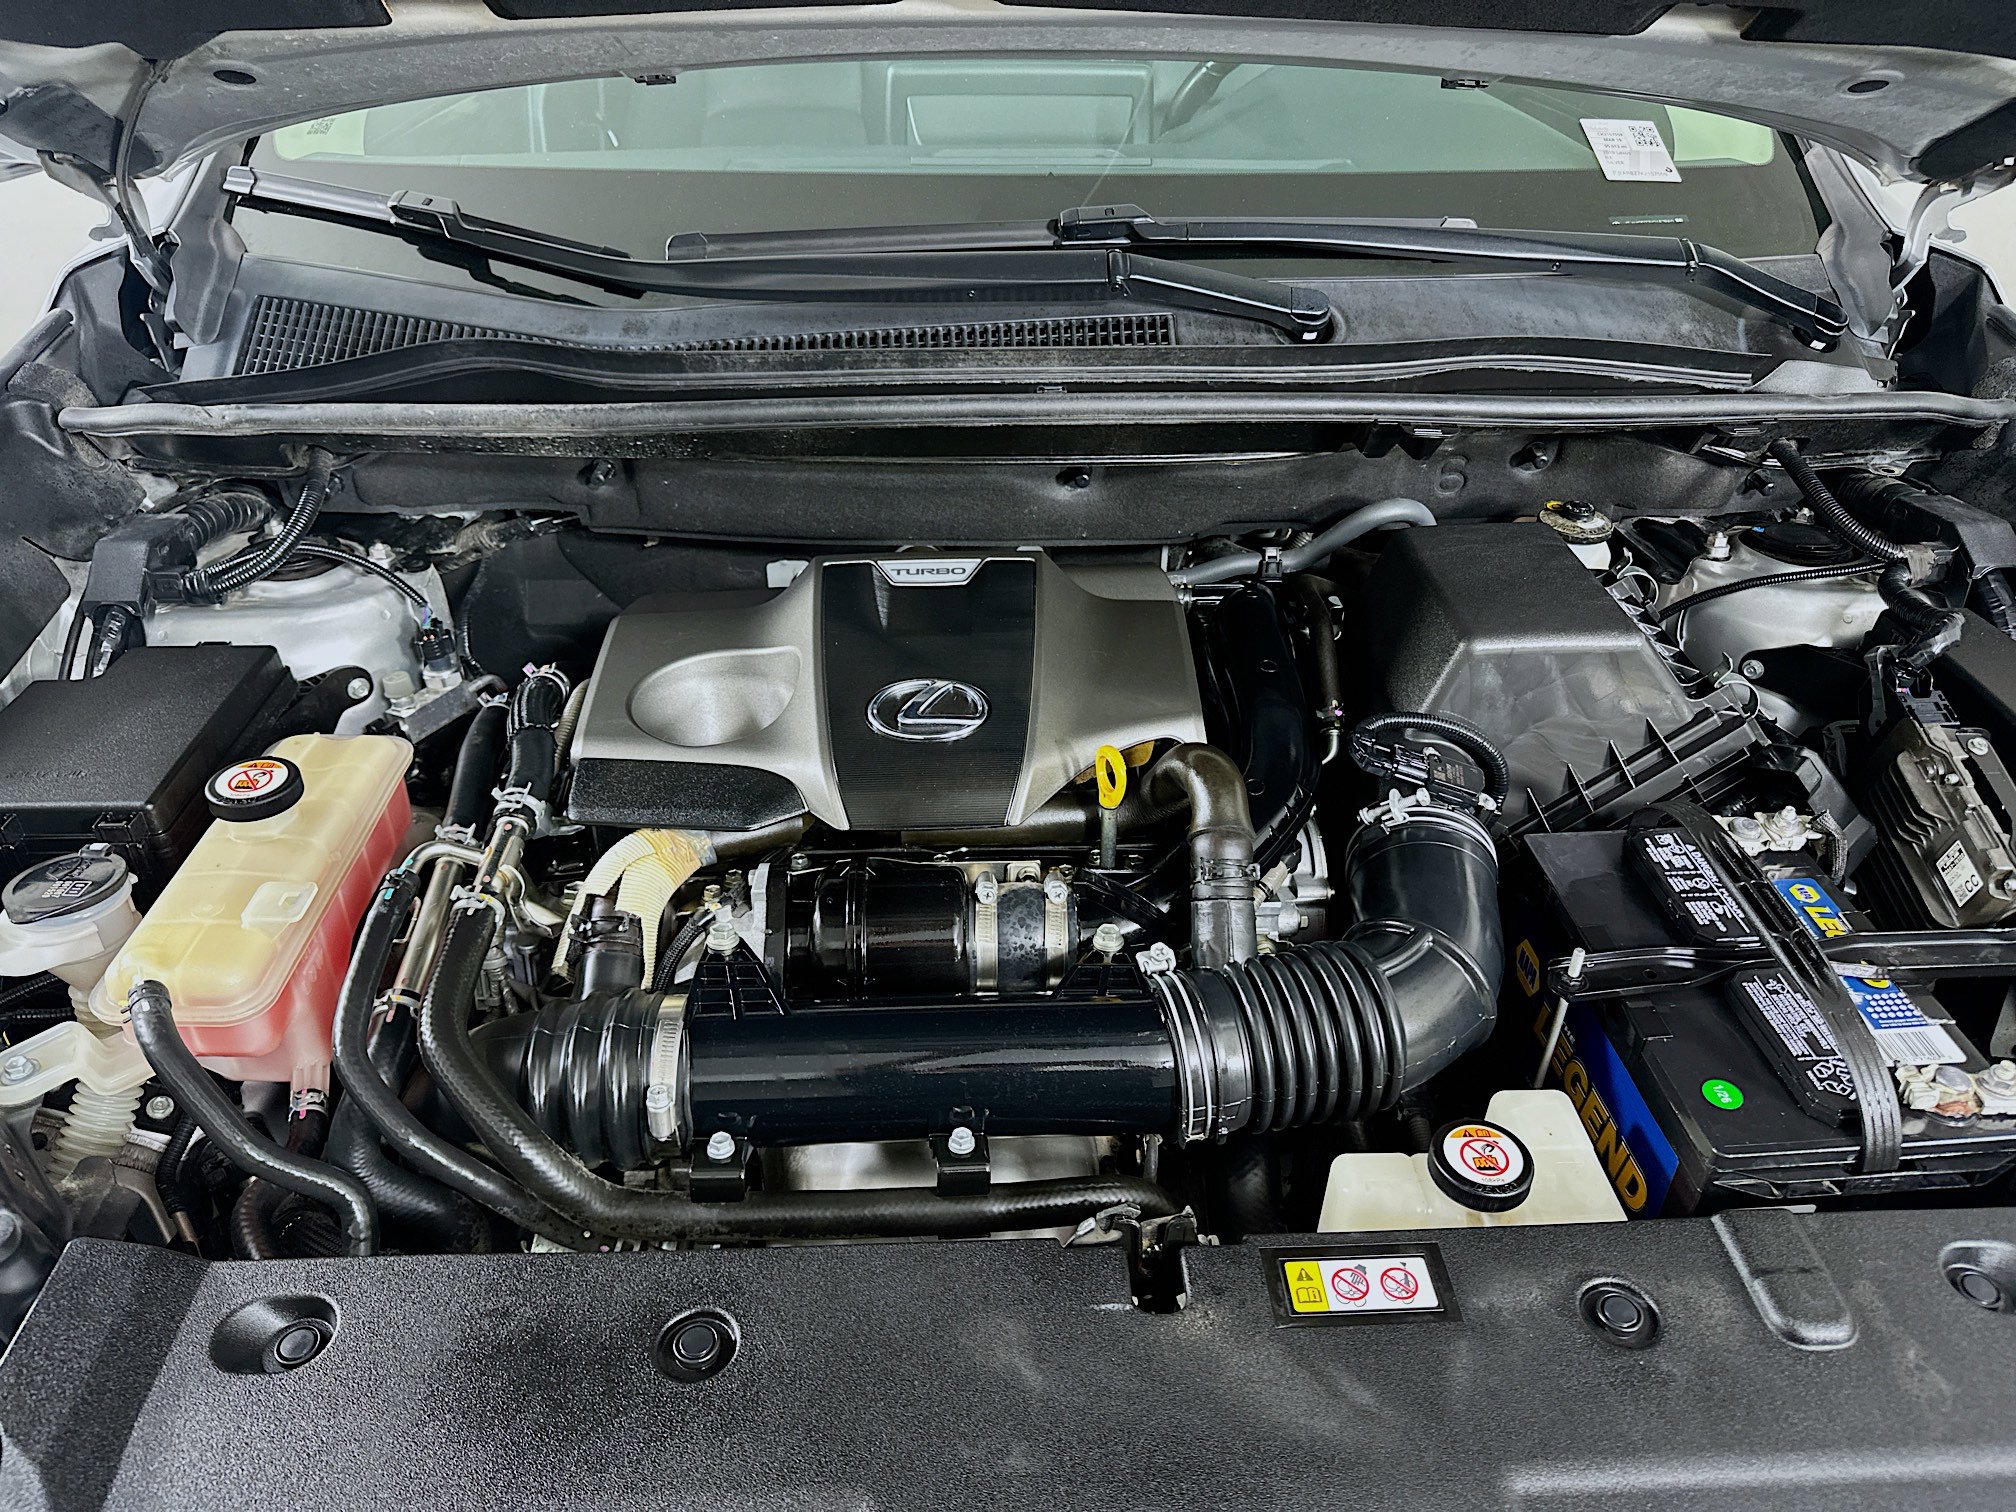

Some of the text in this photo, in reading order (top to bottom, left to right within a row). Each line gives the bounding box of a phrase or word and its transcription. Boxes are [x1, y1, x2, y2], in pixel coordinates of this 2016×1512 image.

[890, 567, 966, 576] TURBO
[1964, 874, 1980, 893] CC
[1712, 1084, 1732, 1104] 1/26
[1533, 1001, 1648, 1212] LEGEND
[1472, 1182, 1518, 1195] DENSO
